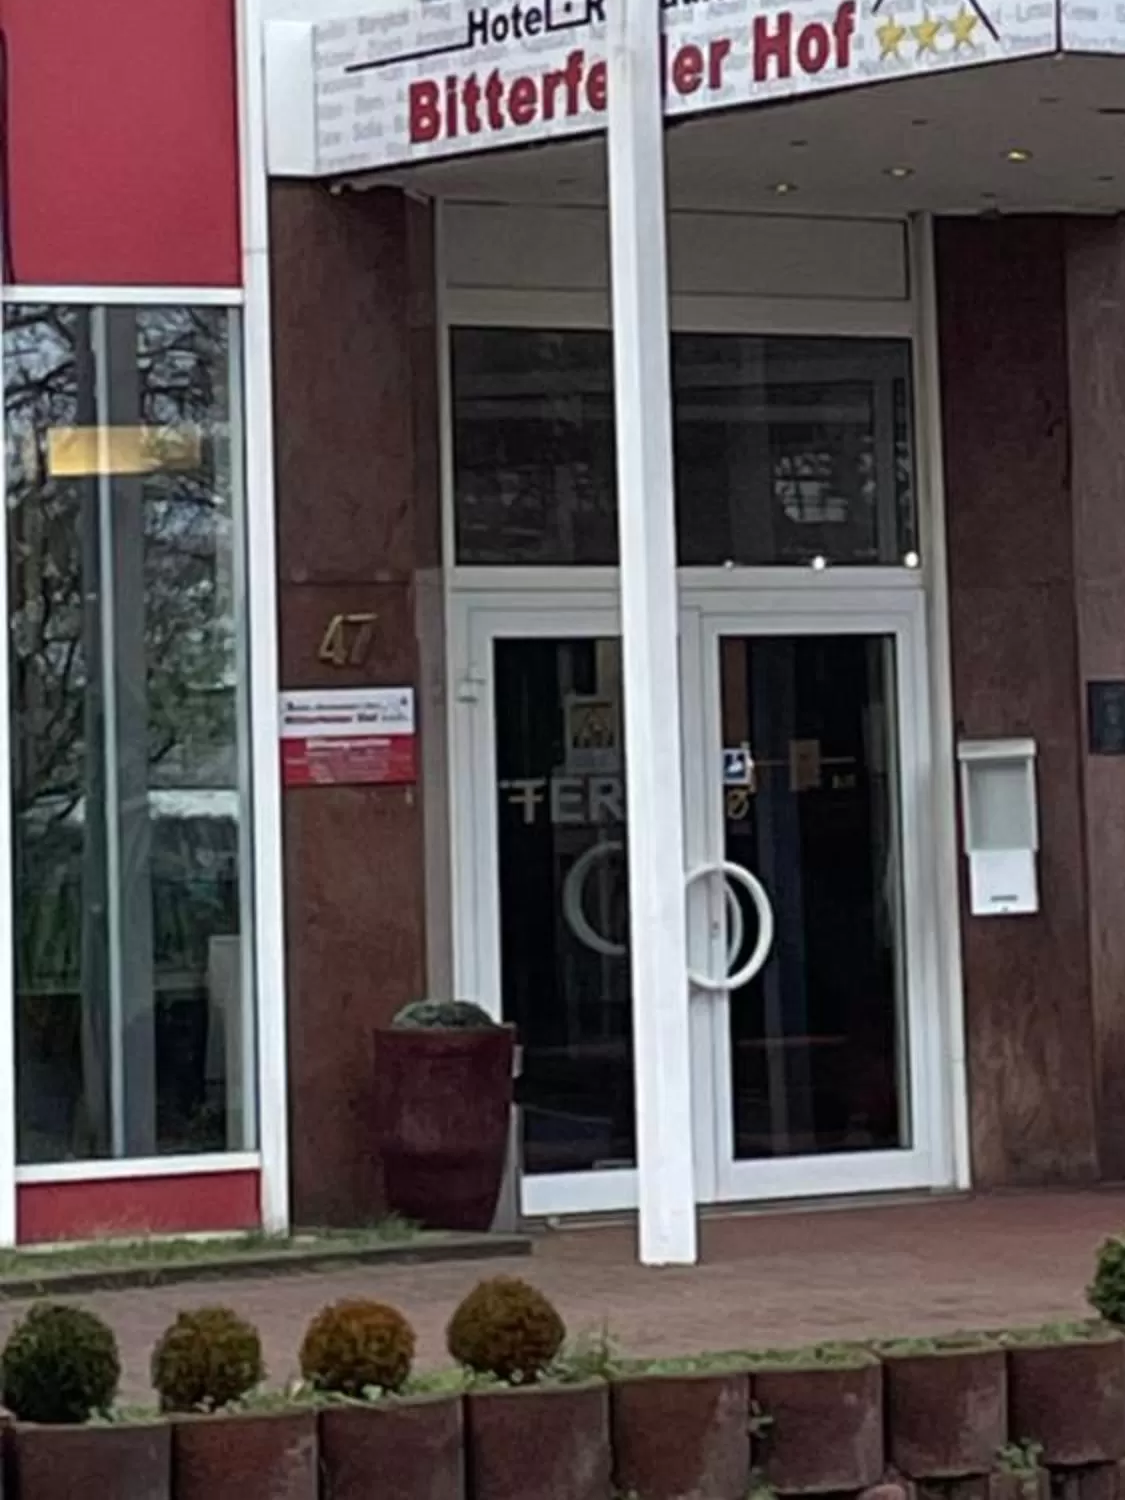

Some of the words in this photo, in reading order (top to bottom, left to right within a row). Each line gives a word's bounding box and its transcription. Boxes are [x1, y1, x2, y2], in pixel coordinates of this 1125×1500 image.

[408, 37, 732, 145] Bitterfeer
[752, 0, 857, 83] Hof
[318, 613, 379, 664] 47
